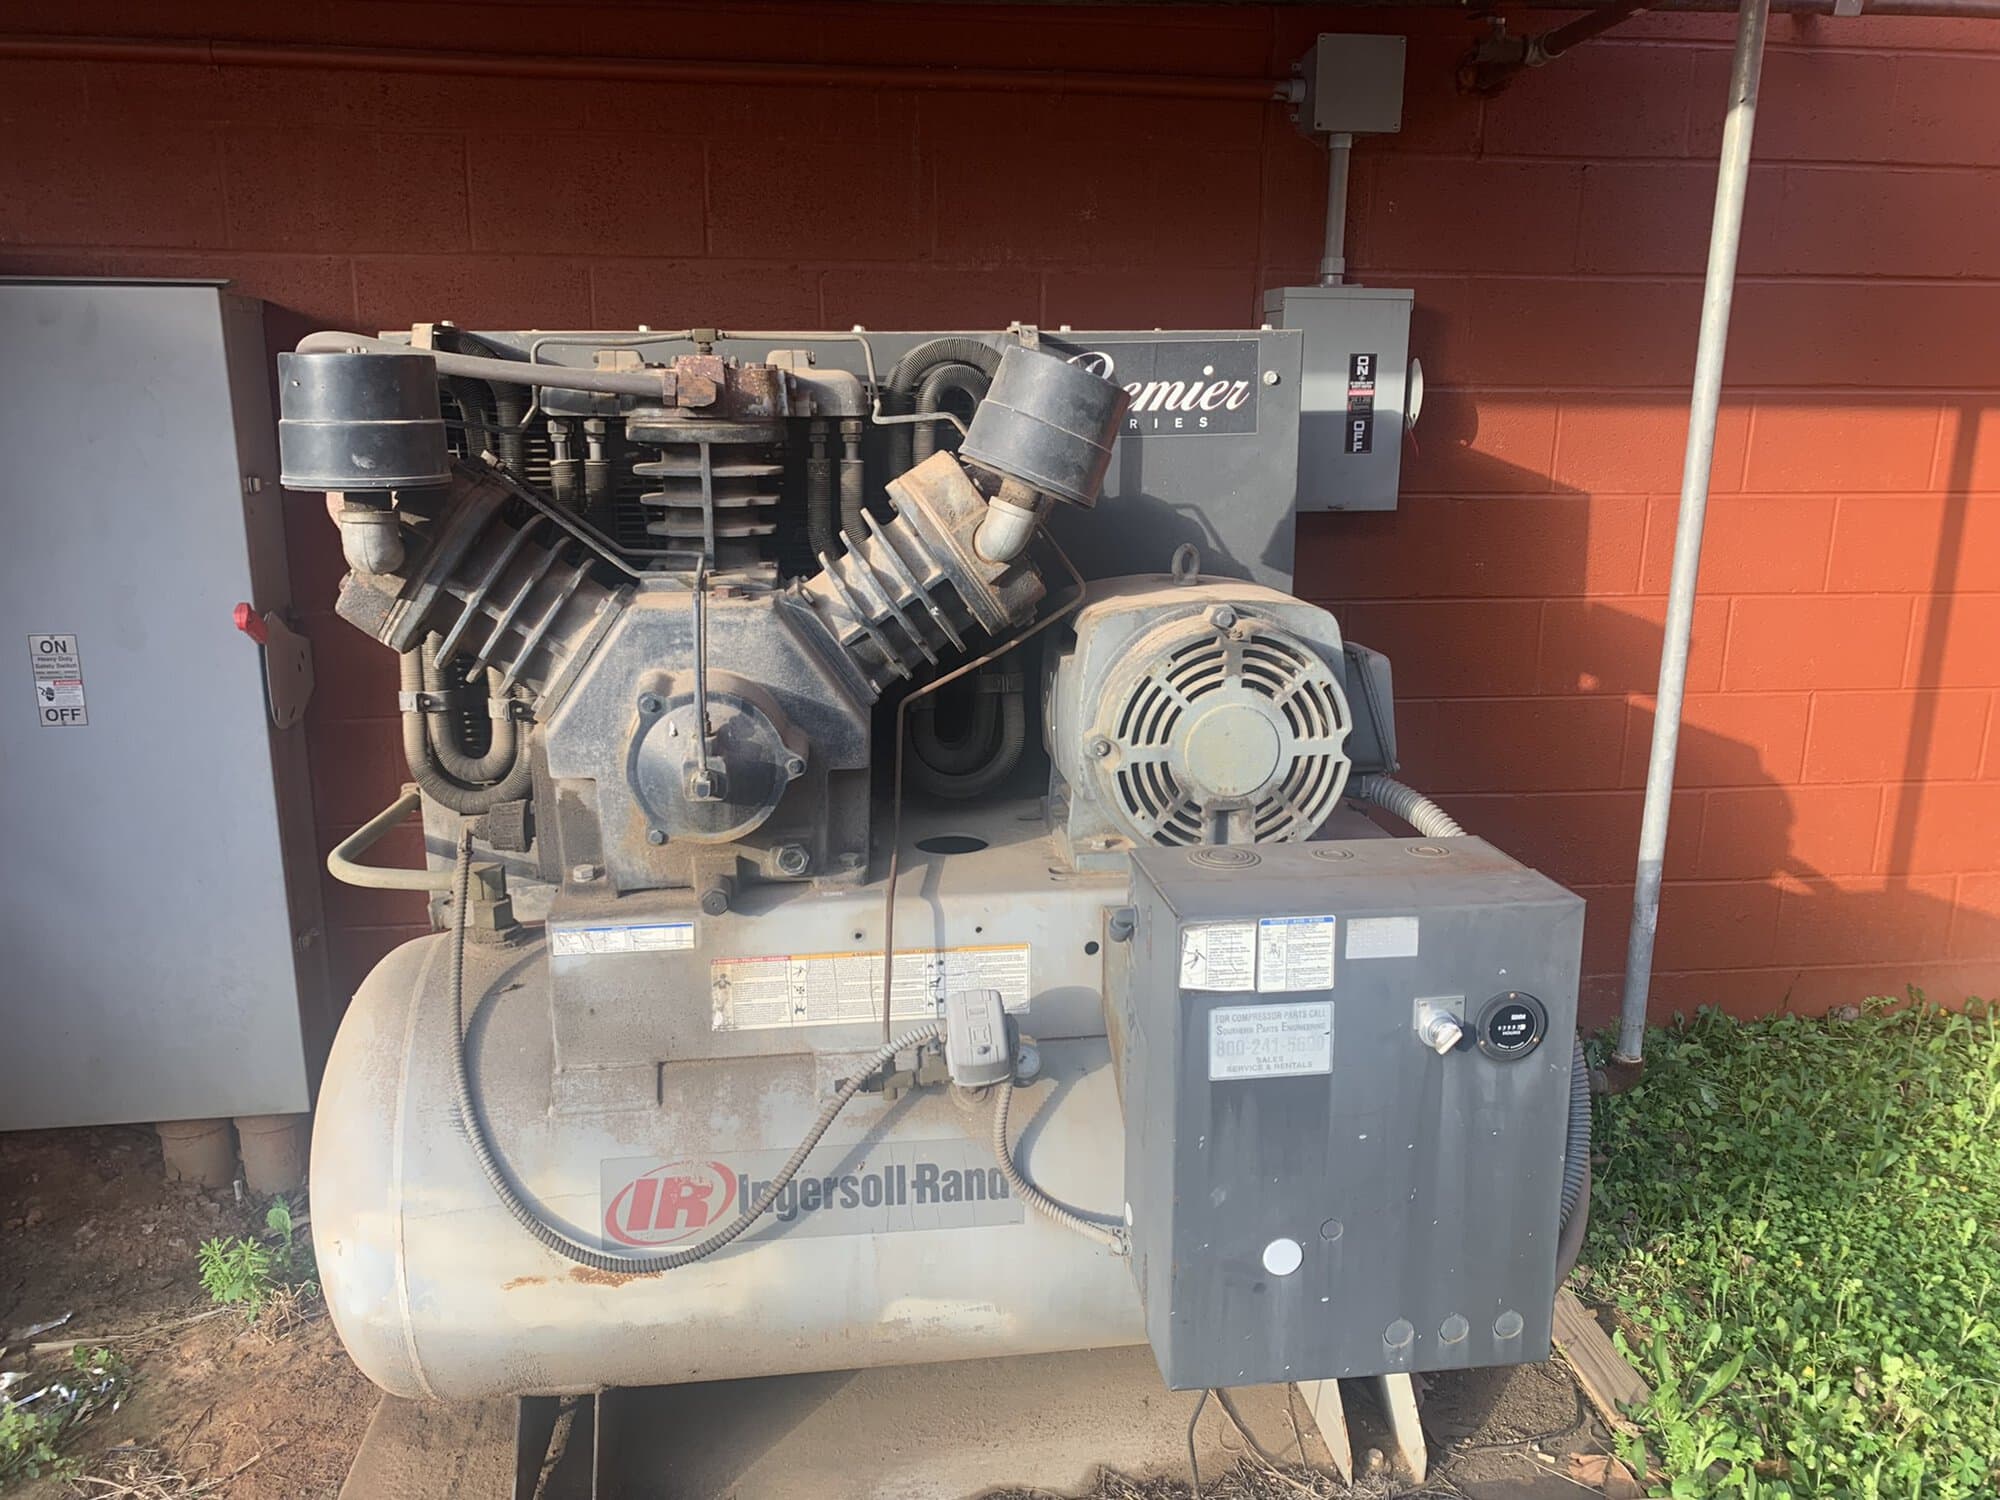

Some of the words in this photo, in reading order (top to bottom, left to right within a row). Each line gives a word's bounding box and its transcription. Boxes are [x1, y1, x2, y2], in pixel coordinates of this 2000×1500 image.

[1356, 355, 1370, 376] ON
[1129, 417, 1209, 429] RIES
[40, 640, 67, 654] ON
[45, 708, 81, 722] OFF
[1215, 1013, 1231, 1023] FOR
[1231, 1011, 1281, 1022] COMPRESSOR
[1283, 1009, 1308, 1020] PARTS
[1308, 1008, 1326, 1018] CALL
[1226, 1063, 1263, 1073] SERVICE
[1273, 1061, 1313, 1070] RENTALS
[626, 1176, 714, 1231] IR
